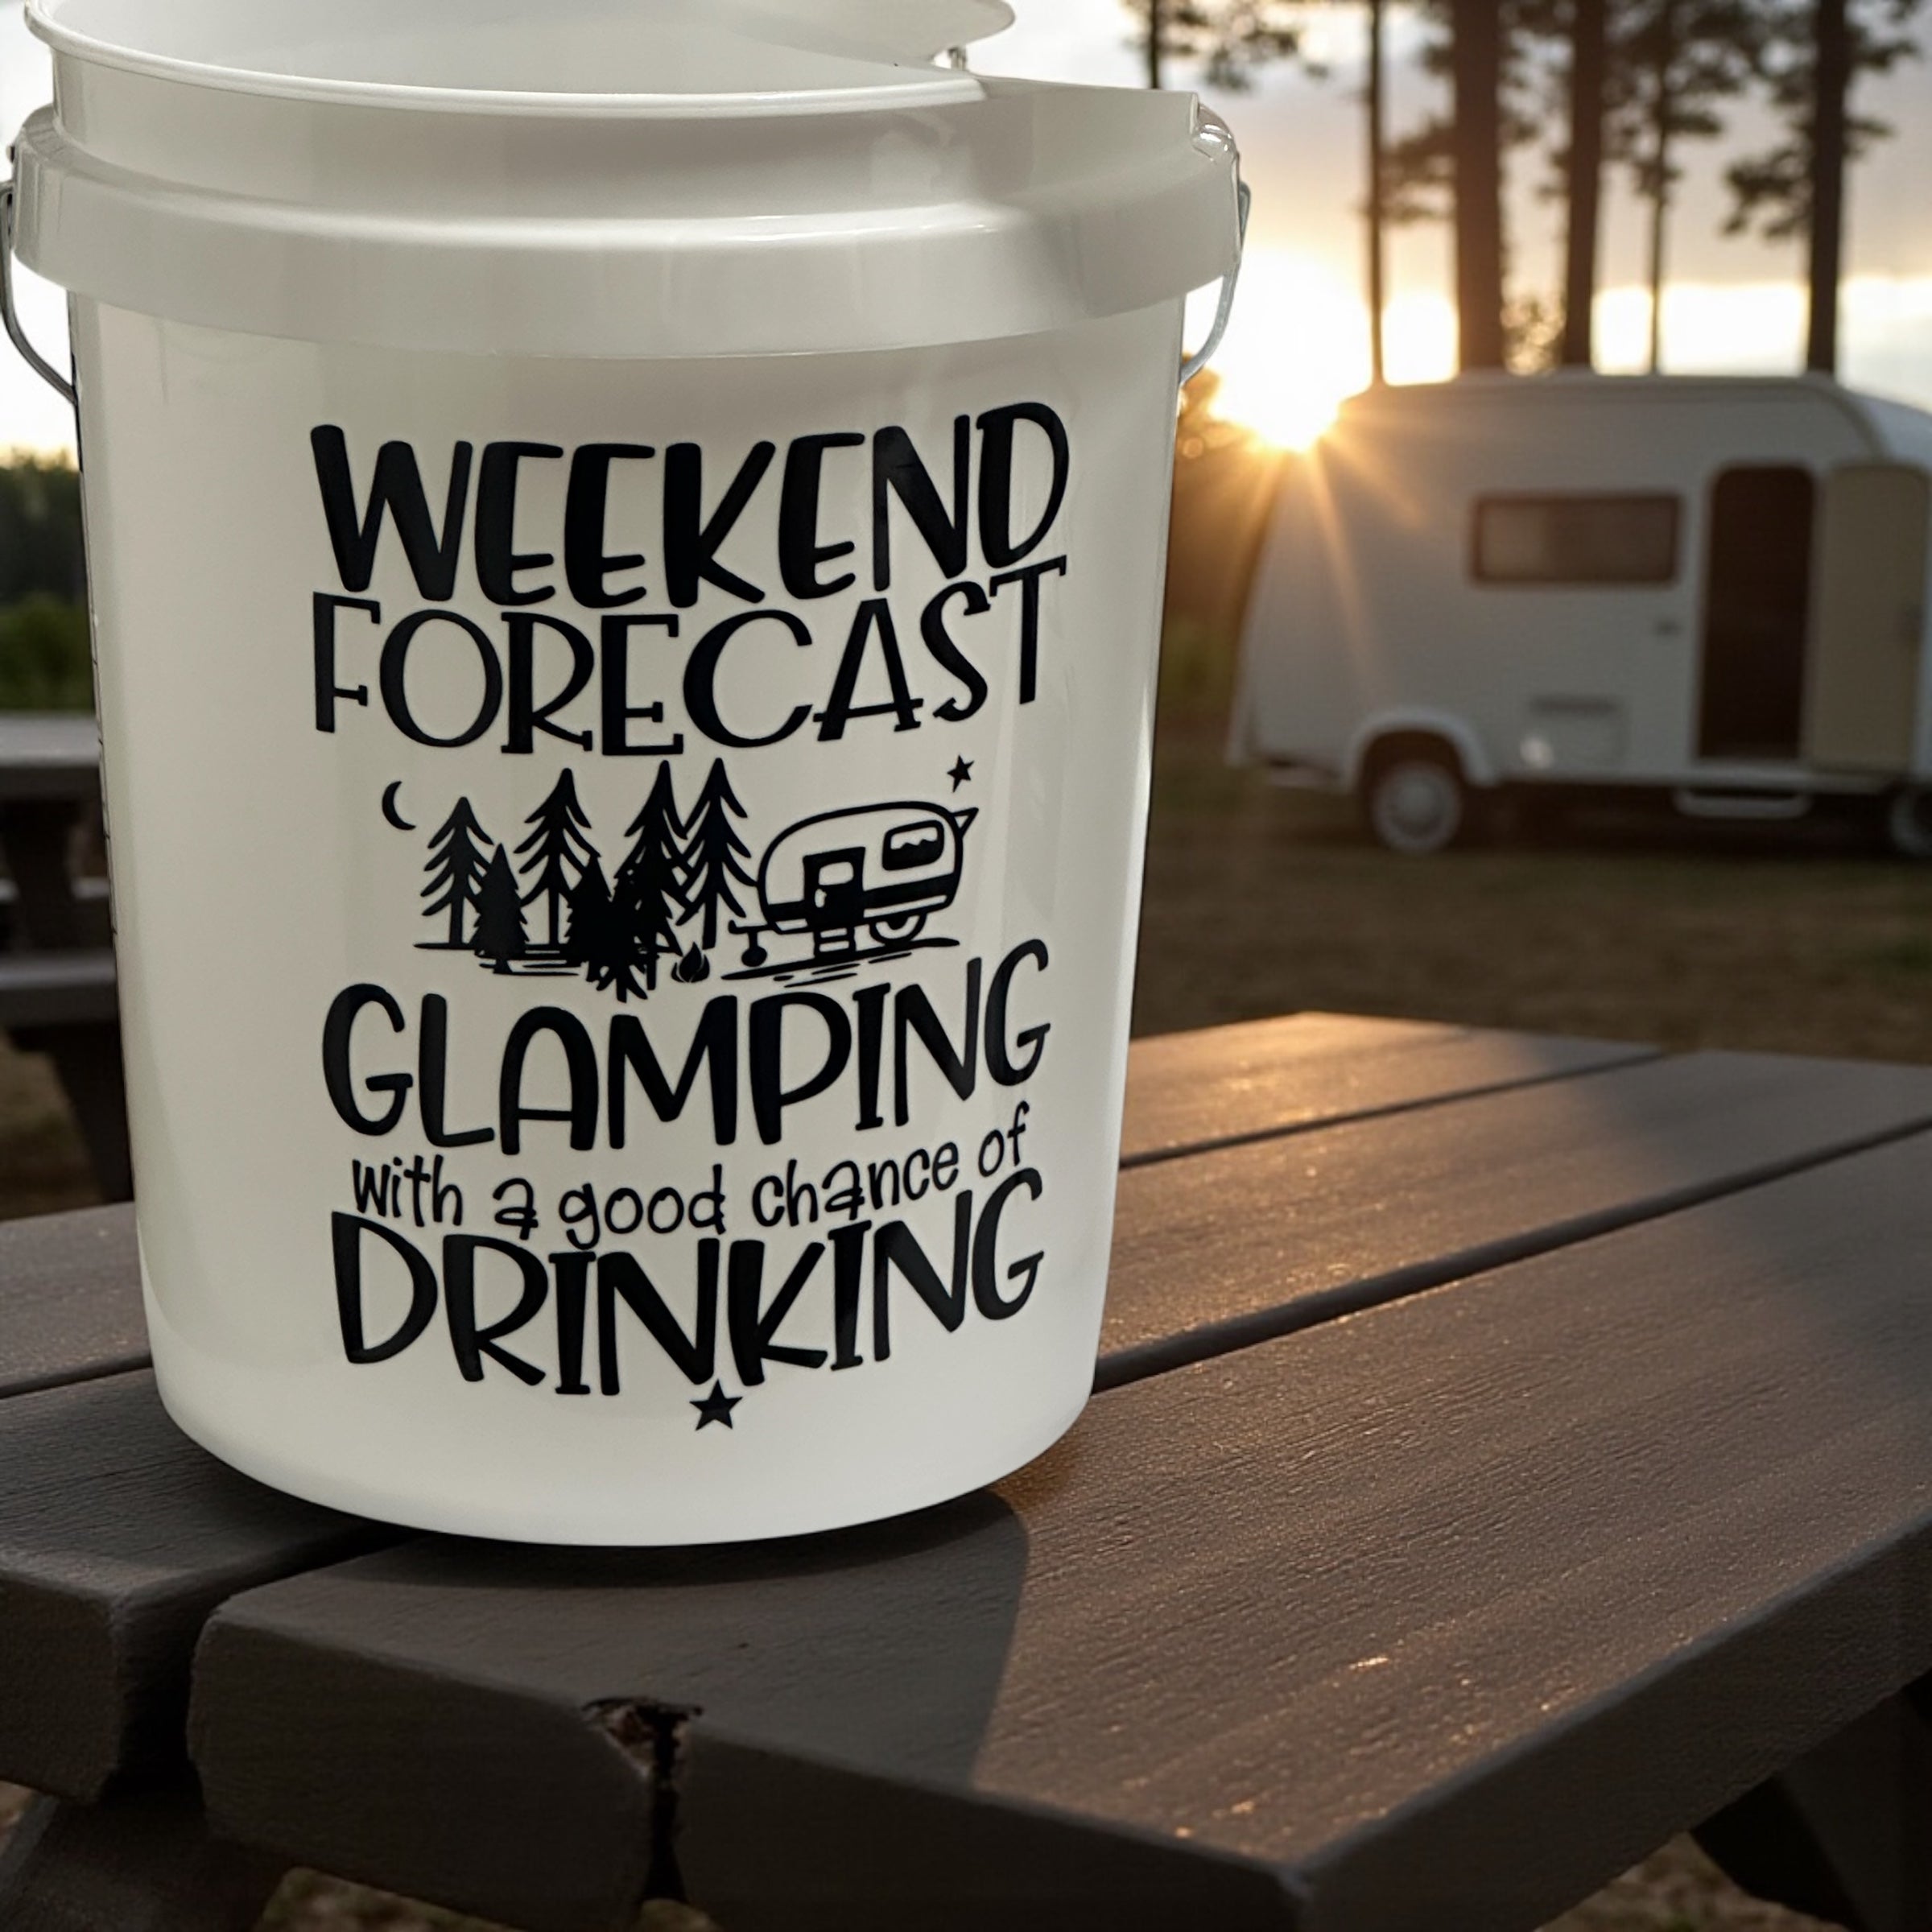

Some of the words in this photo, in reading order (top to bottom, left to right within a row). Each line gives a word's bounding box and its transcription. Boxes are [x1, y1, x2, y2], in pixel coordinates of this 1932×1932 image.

[309, 402, 1070, 609] WEEKEND
[312, 554, 1067, 757] FORECAST
[322, 939, 1051, 1156] GLAMPING
[352, 1154, 464, 1228] with
[492, 1177, 539, 1241] a
[559, 1163, 727, 1249] good
[751, 1141, 959, 1228] chance
[977, 1100, 1030, 1178] of
[331, 1167, 1045, 1397] DRINKING
